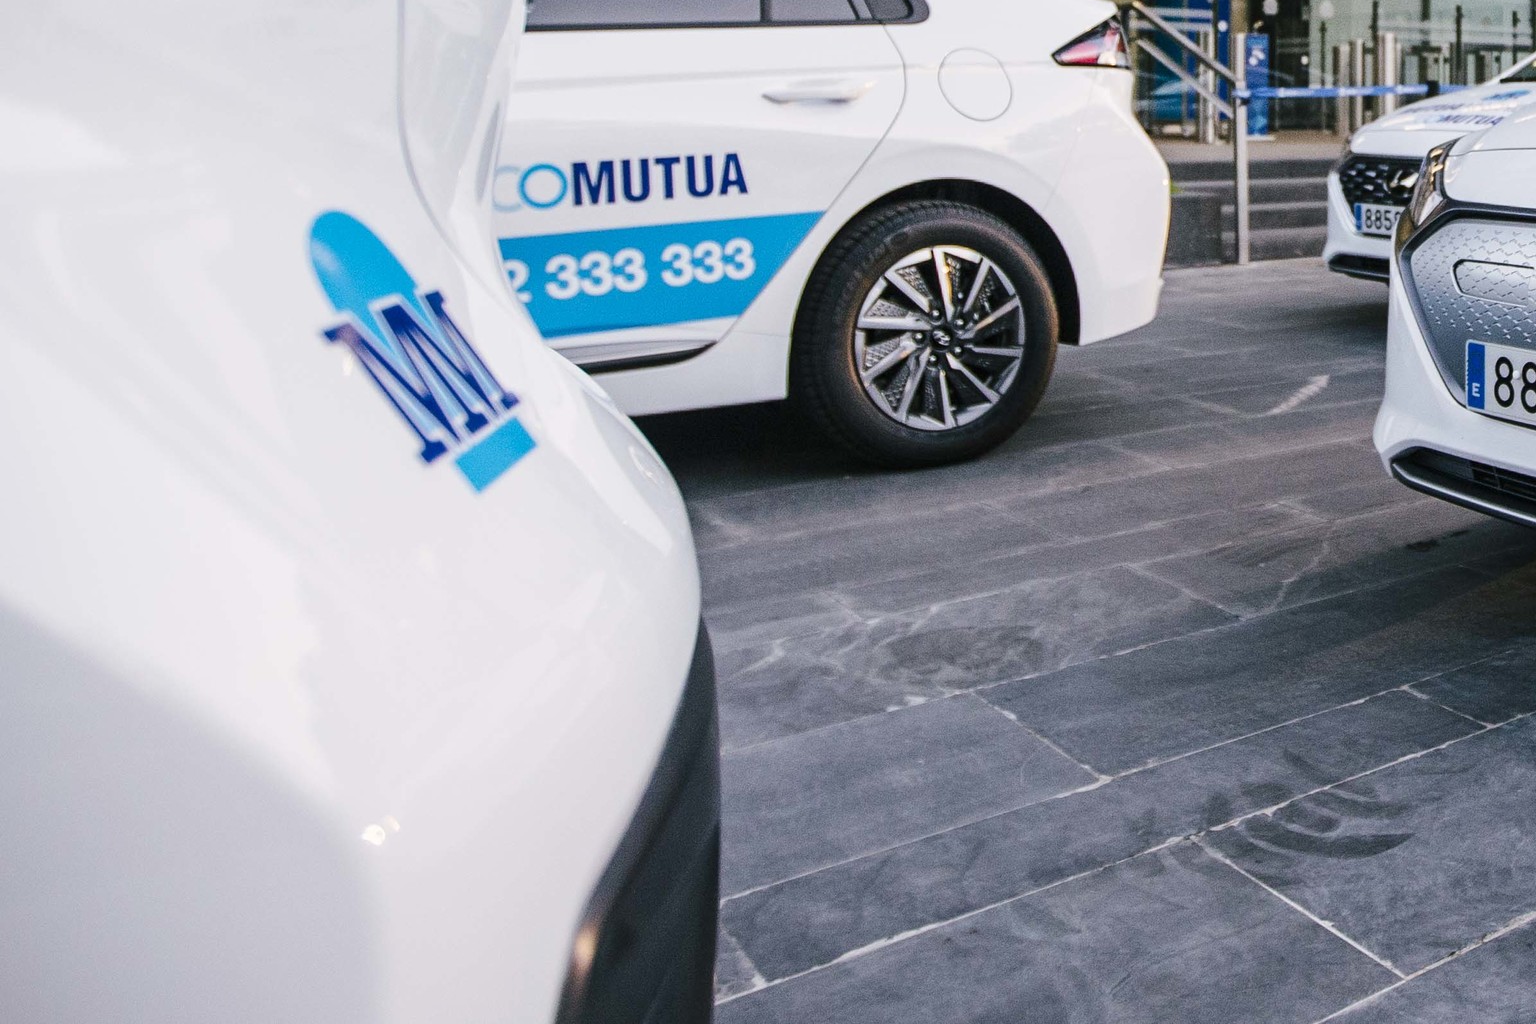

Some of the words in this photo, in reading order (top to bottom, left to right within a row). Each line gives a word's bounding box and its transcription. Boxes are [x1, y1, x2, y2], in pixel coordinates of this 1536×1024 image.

[544, 248, 648, 300] 333
[661, 237, 756, 287] 333
[1472, 382, 1481, 397] E
